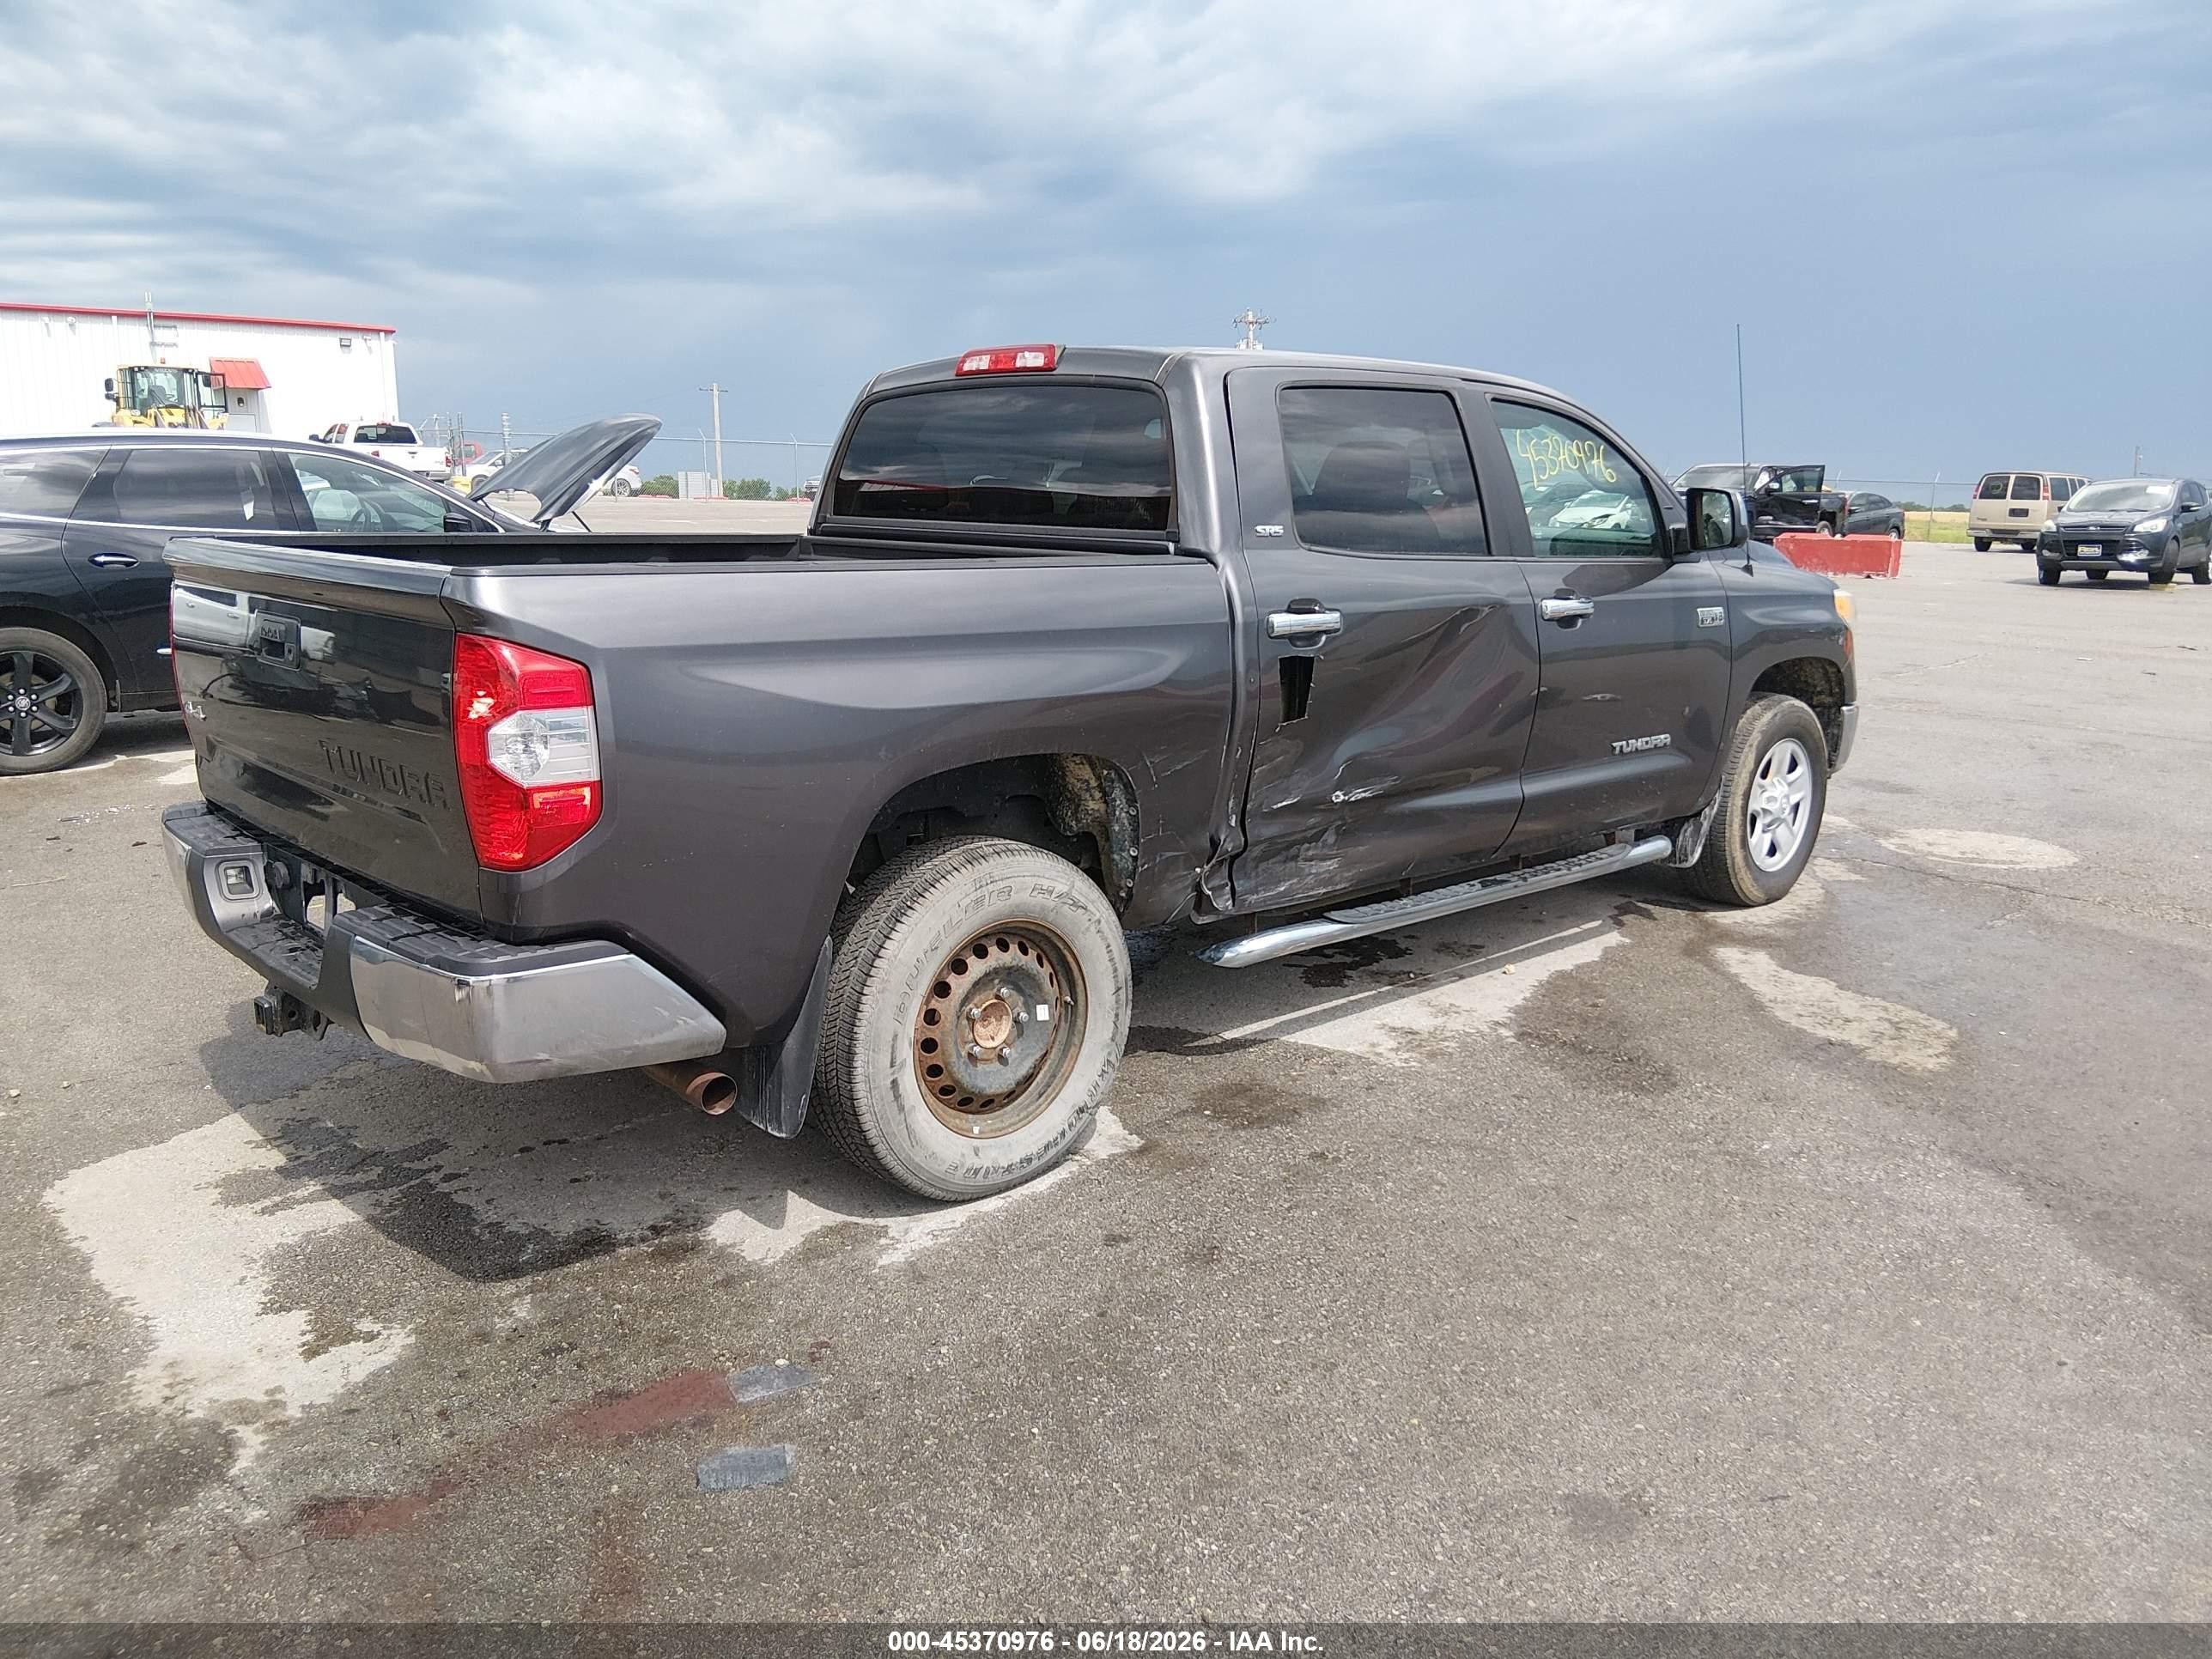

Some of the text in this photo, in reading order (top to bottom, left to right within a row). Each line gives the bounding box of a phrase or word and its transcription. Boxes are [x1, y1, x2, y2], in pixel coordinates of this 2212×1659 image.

[1516, 428, 1616, 489] 45370976
[1612, 733, 1671, 755] TUNDRA
[319, 739, 452, 811] TUNDRA
